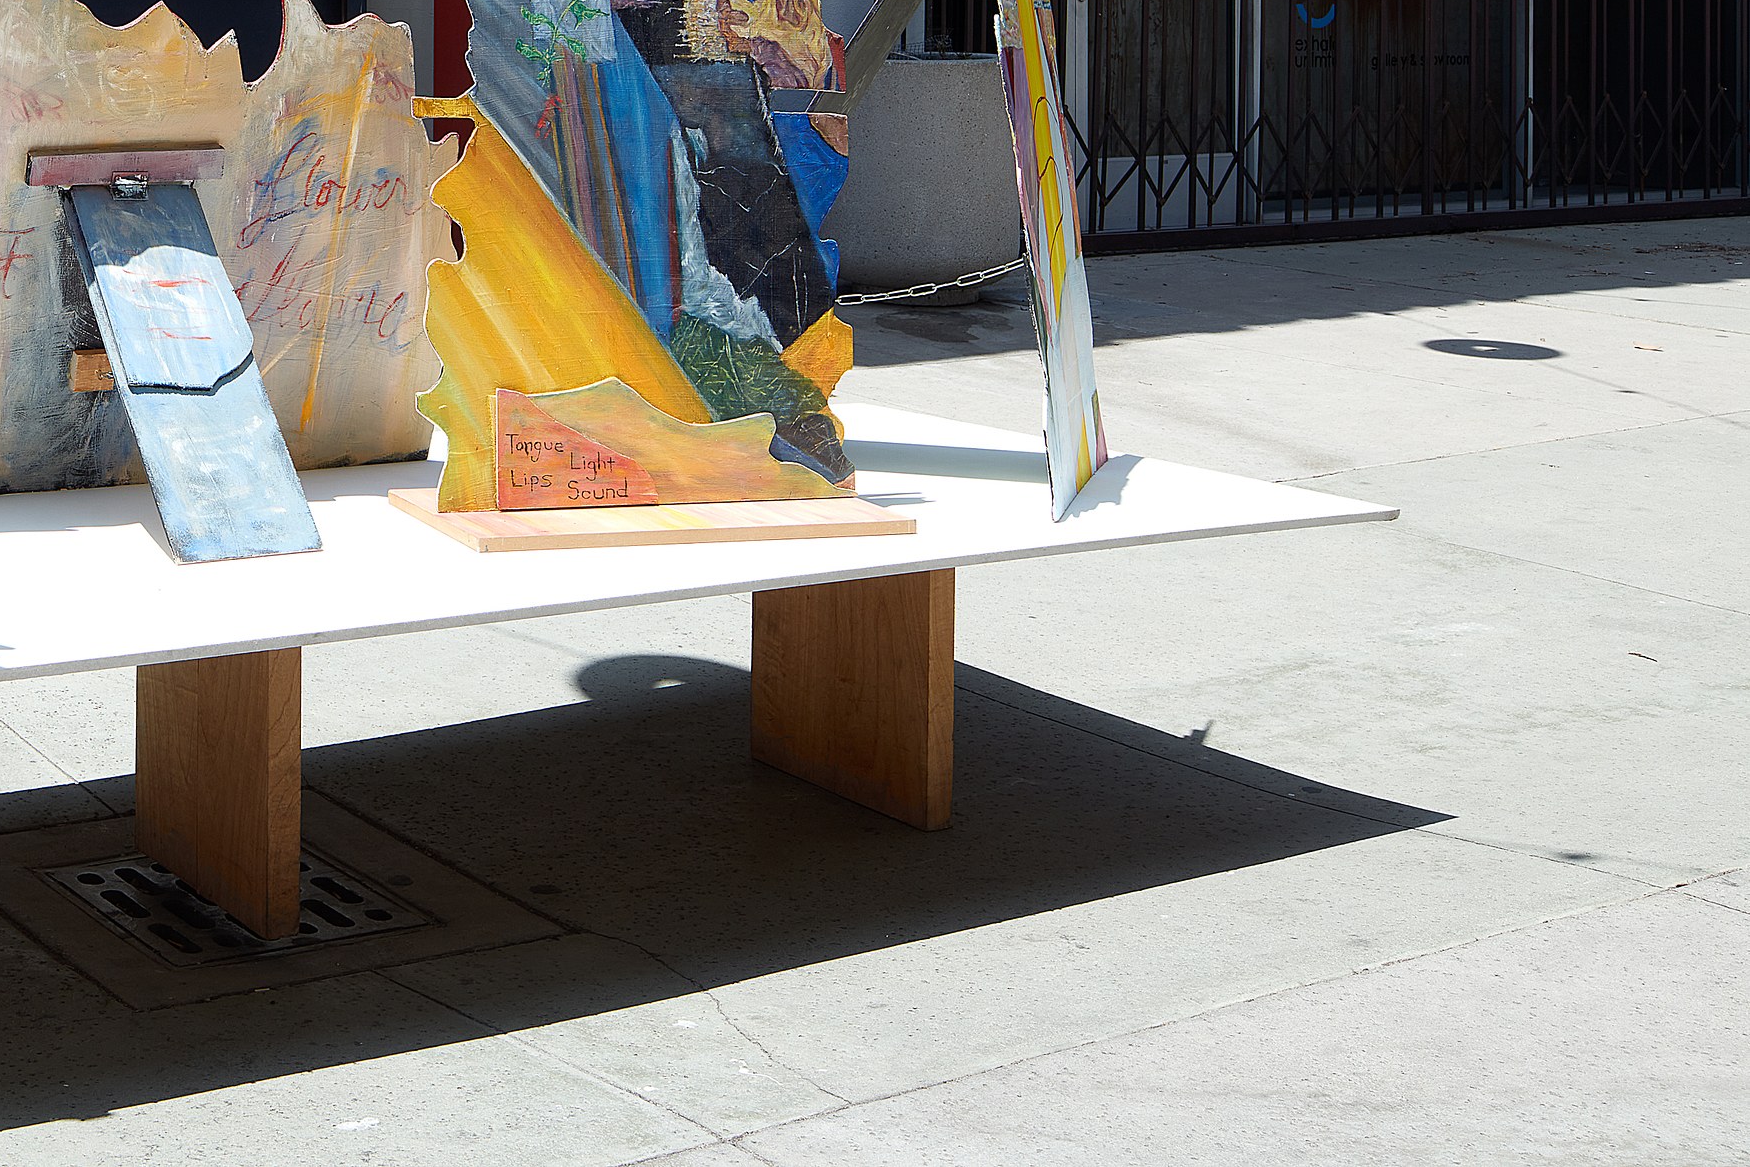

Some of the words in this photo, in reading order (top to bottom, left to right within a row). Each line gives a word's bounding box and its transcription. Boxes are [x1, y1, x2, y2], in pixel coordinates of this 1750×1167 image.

[506, 434, 564, 462] Tongue
[570, 452, 615, 481] Light
[510, 470, 553, 492] Lips
[568, 477, 628, 500] Sound
